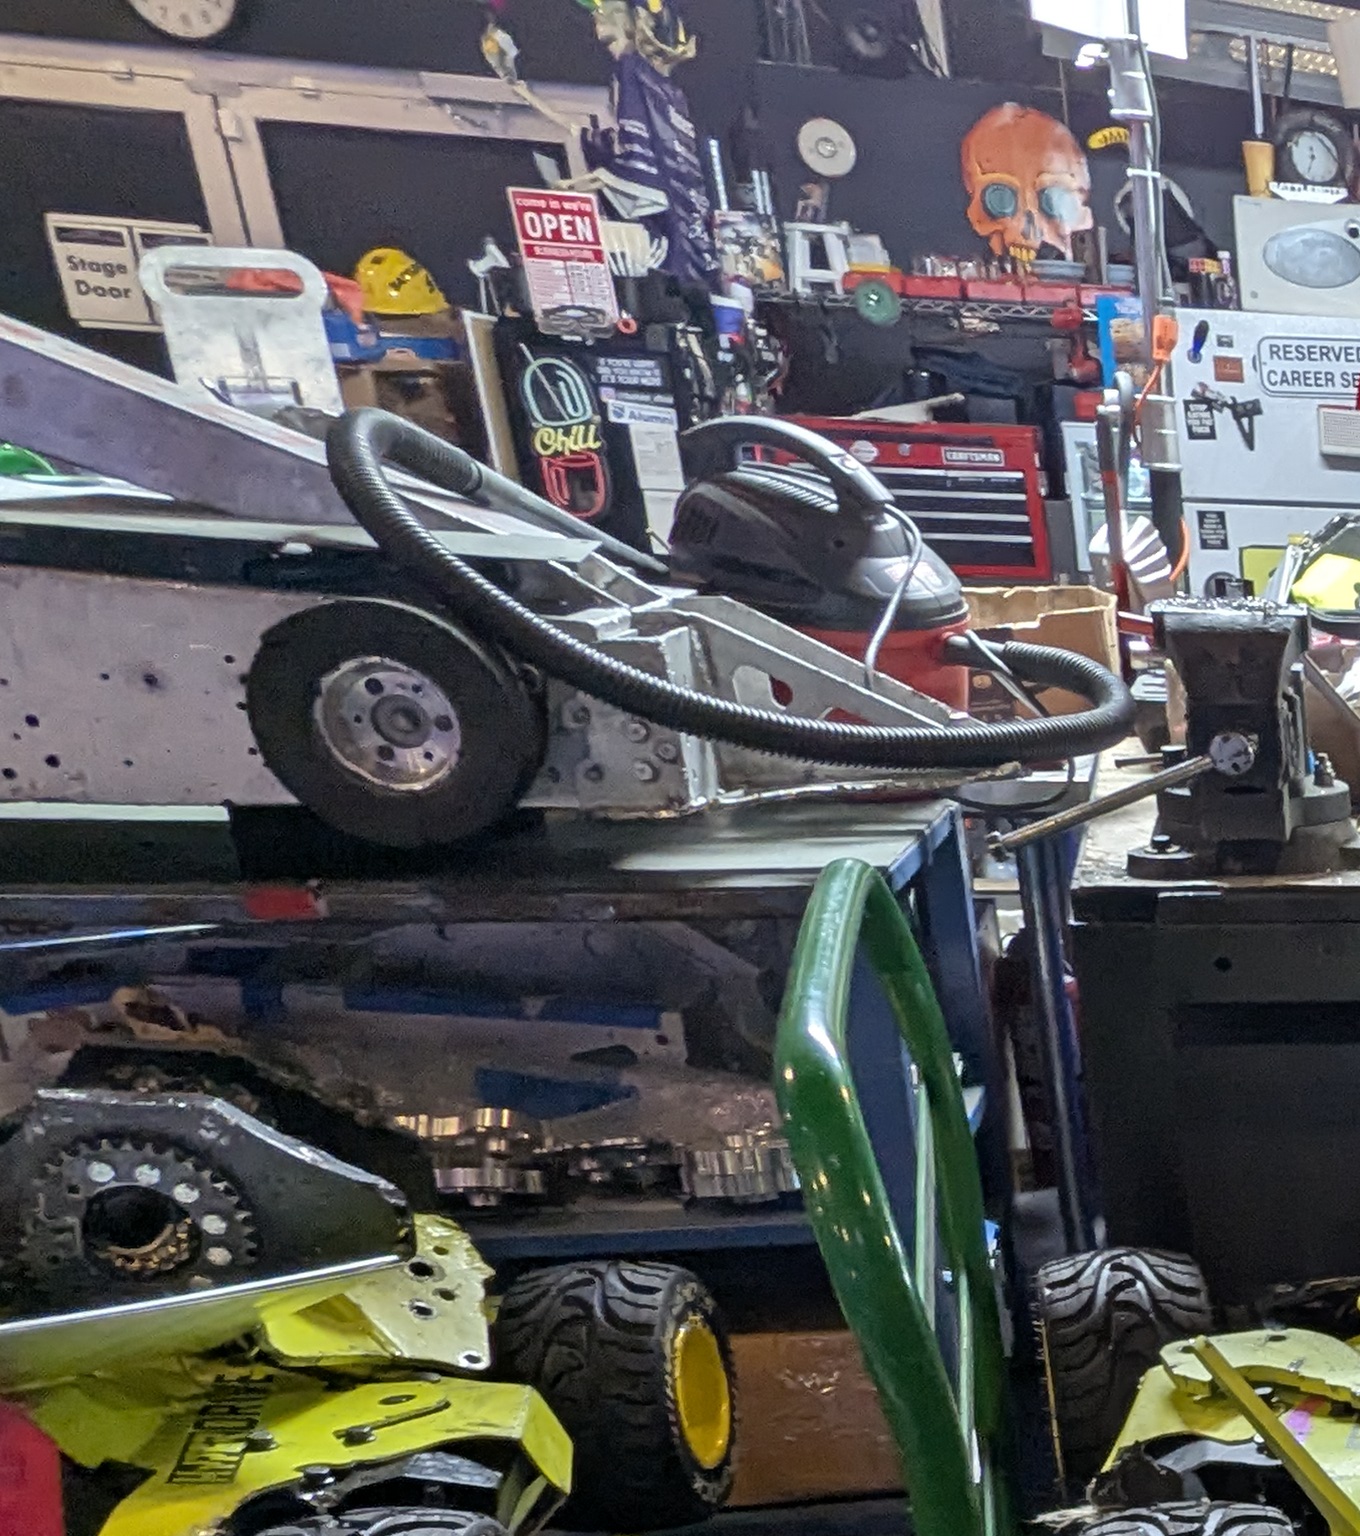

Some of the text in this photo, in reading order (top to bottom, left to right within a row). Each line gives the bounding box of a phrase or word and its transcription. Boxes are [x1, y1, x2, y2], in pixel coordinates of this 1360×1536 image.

[522, 210, 595, 242] OPEN
[66, 254, 128, 278] Stage
[74, 279, 133, 299] Door
[1266, 369, 1336, 388] CAREER
[533, 424, 602, 457] Chill
